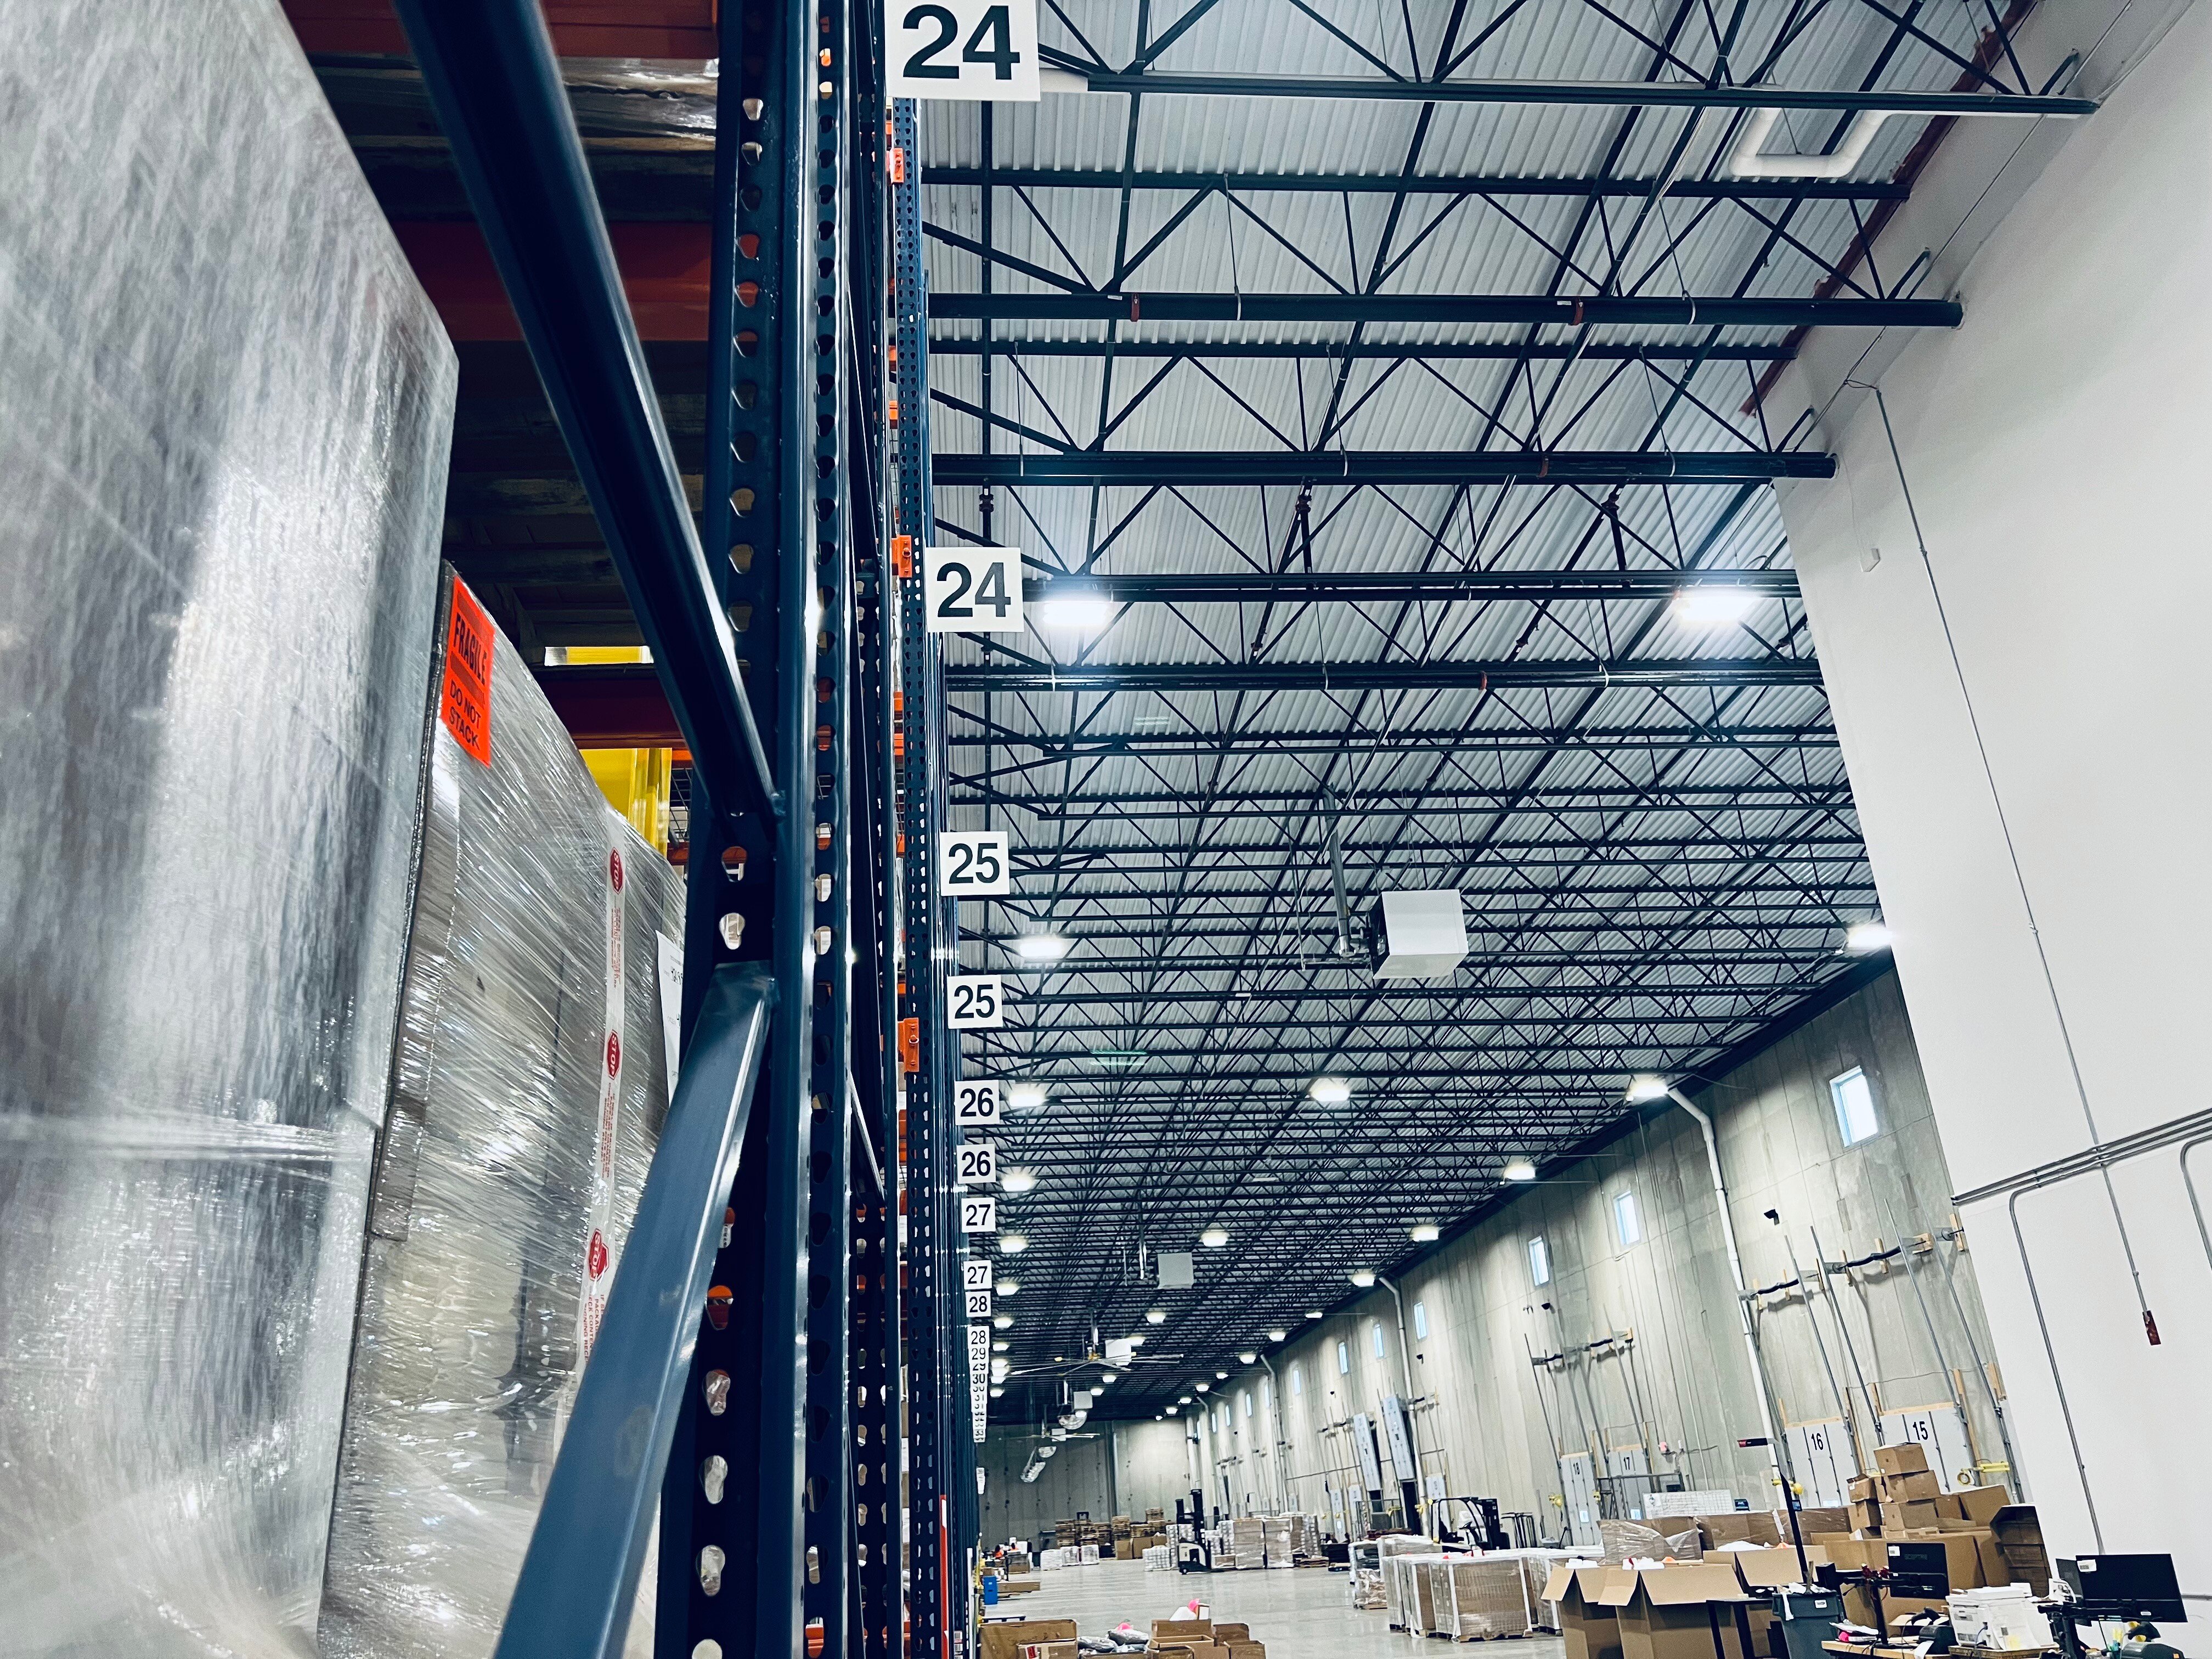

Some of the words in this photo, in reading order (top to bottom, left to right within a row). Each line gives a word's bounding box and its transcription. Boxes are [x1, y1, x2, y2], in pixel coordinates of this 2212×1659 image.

[903, 4, 1020, 80] 24
[937, 562, 1011, 617] 24
[454, 612, 487, 685] FRAGILE
[450, 679, 462, 706] DO
[464, 697, 481, 729] NOT
[449, 706, 479, 751] STACK
[949, 843, 1000, 884] 25
[955, 984, 995, 1019] 25
[961, 1088, 994, 1117] 26
[962, 1151, 990, 1176] 26
[966, 1204, 990, 1226] 27
[592, 1233, 601, 1277] STOP
[968, 1266, 988, 1284] 27
[969, 1296, 987, 1312] 28
[971, 1330, 986, 1345] 28
[972, 1348, 986, 1360] 29
[973, 1374, 985, 1384] 30
[1812, 1433, 1823, 1450] 16
[1913, 1421, 1928, 1440] 15
[1624, 1457, 1630, 1470] 17
